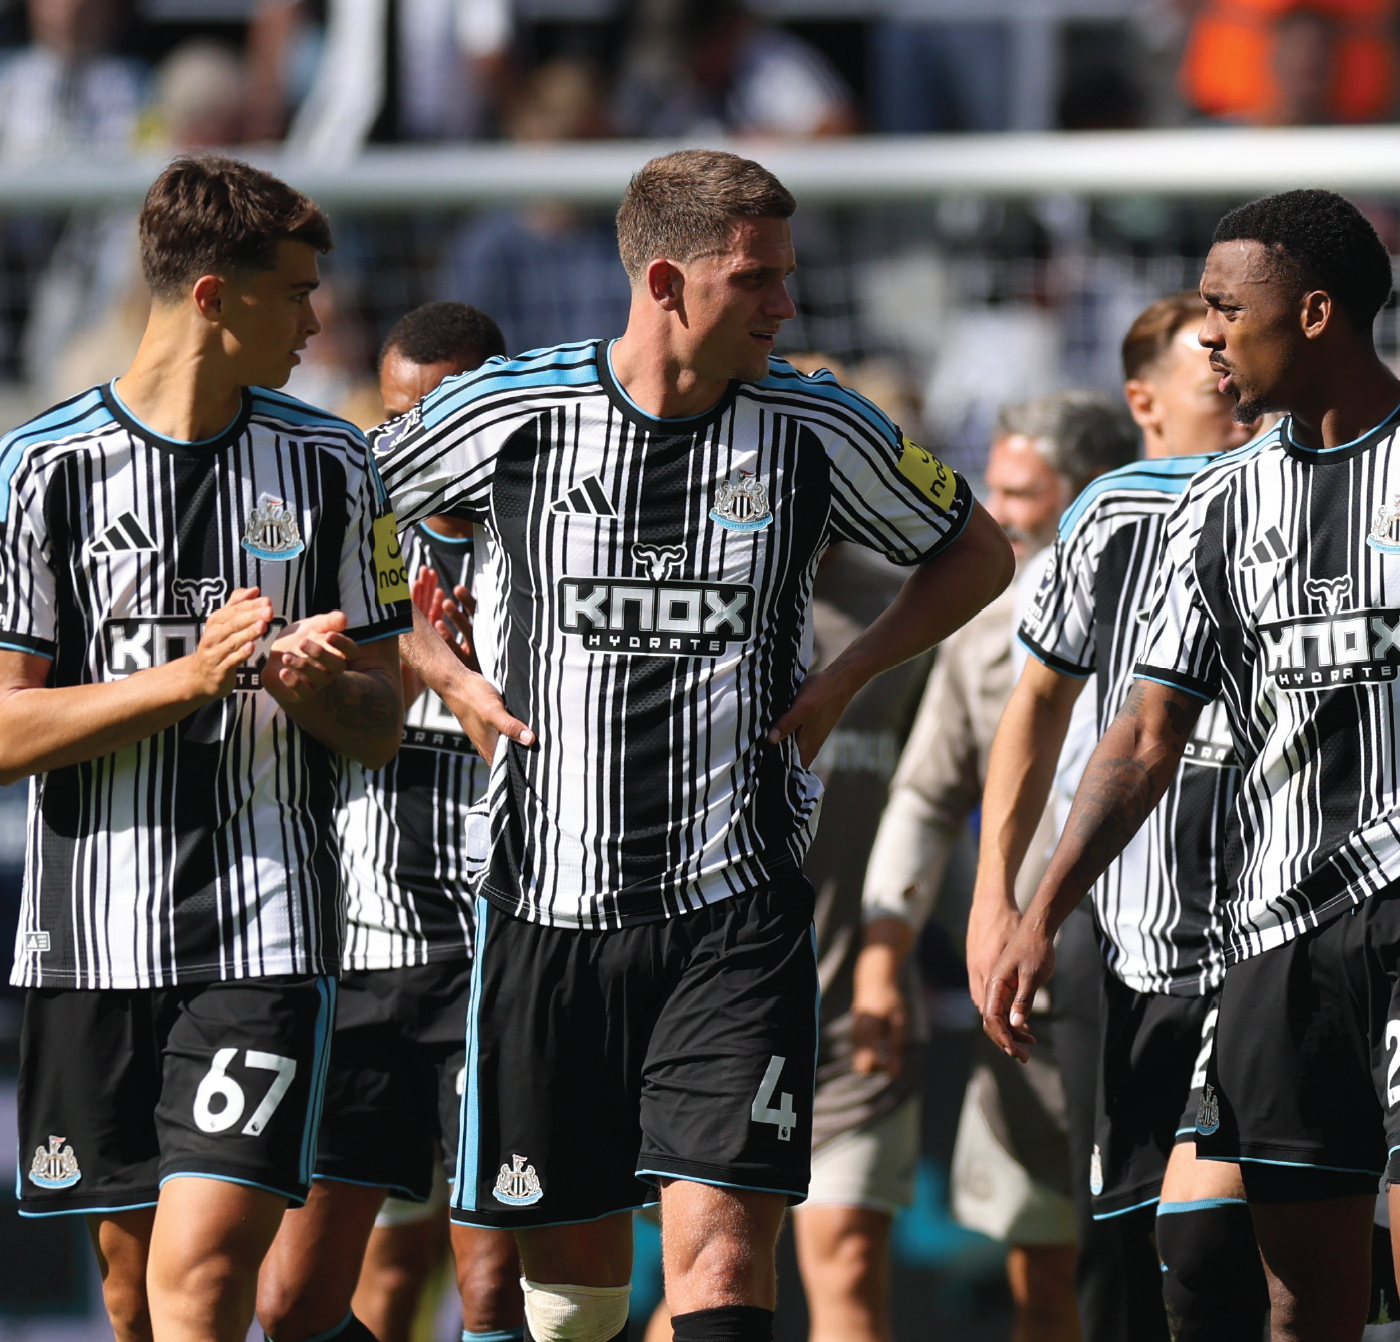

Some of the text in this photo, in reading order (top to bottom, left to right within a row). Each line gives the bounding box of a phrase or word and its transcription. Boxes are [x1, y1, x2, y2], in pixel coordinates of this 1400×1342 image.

[564, 583, 749, 635] KNOX
[589, 635, 721, 651] HYDRATE
[1279, 666, 1391, 686] HYDRATE
[193, 1047, 297, 1137] 67
[751, 1055, 797, 1141] 4
